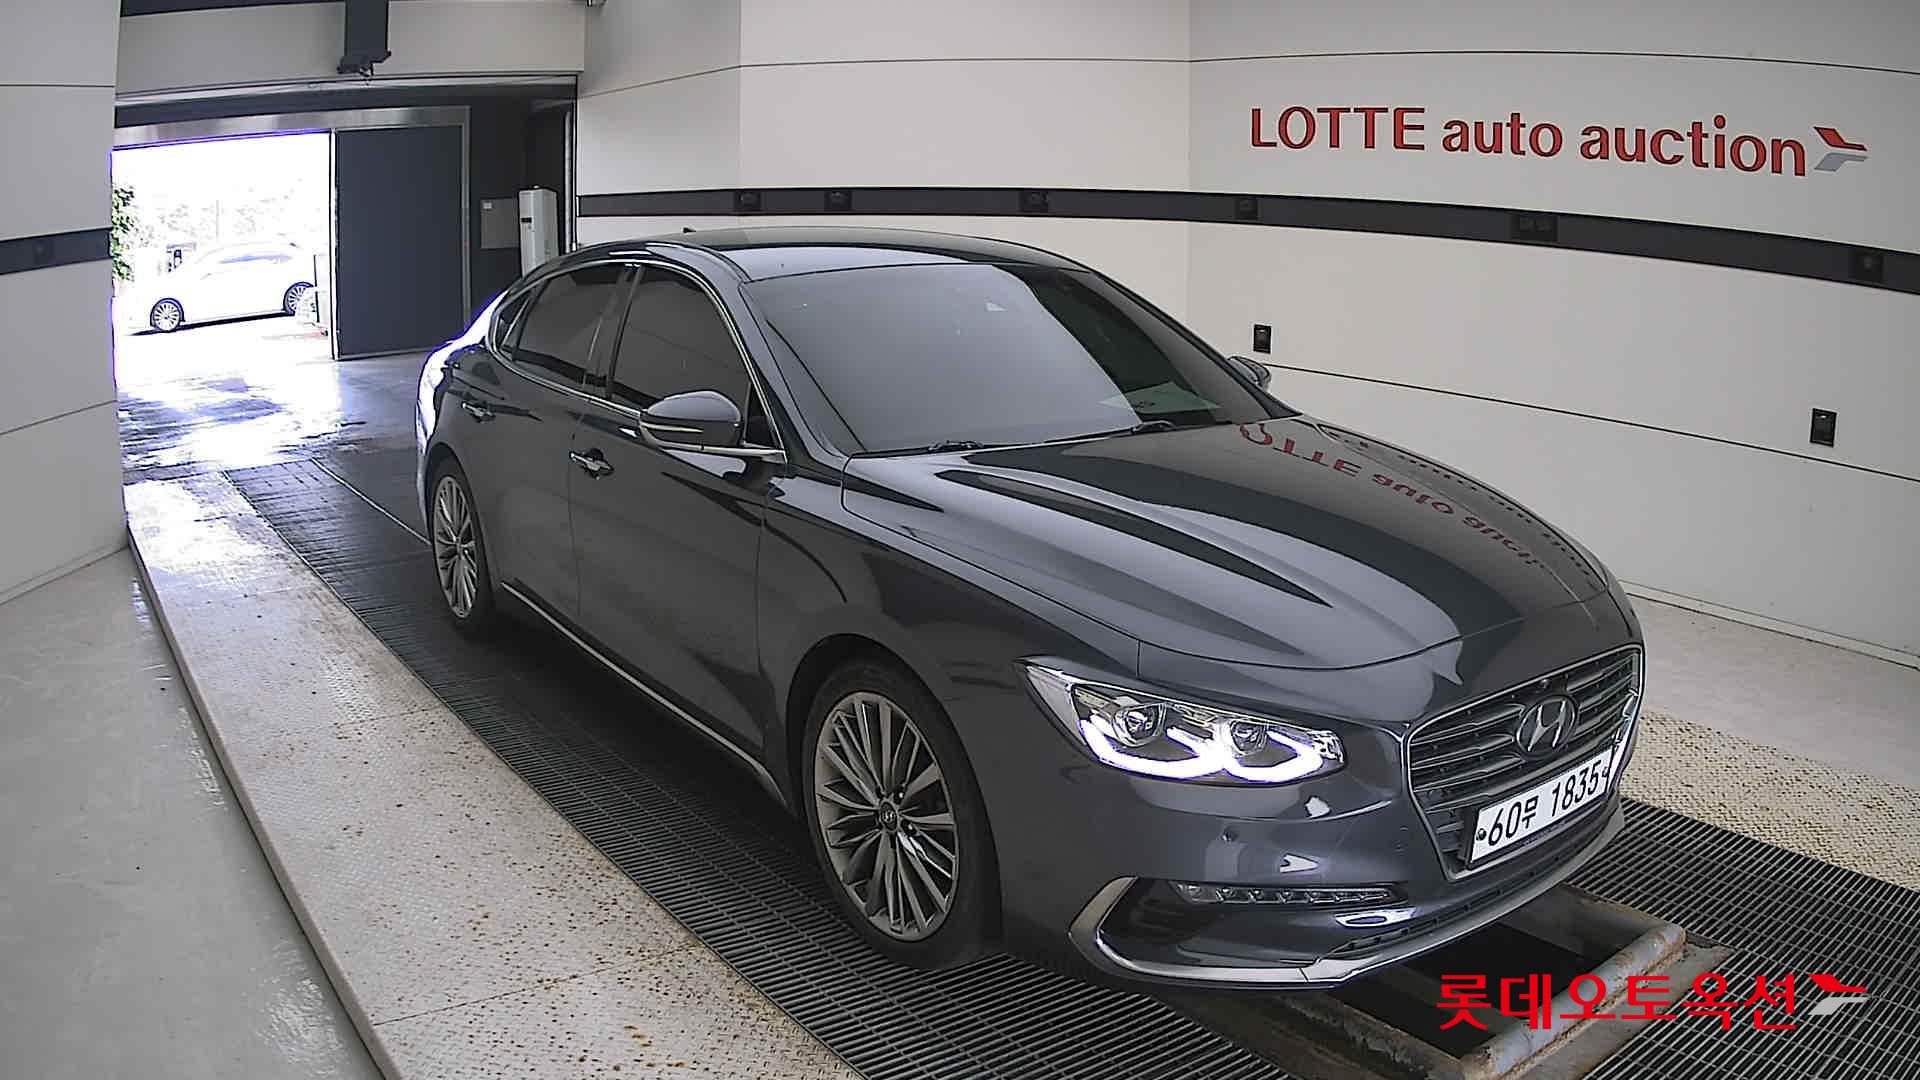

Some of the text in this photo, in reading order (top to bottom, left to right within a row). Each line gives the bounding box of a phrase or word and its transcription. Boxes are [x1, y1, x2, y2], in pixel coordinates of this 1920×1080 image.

[1251, 106, 1808, 177] LOTTE auto auction
[1487, 760, 1602, 846] 60무 1835
